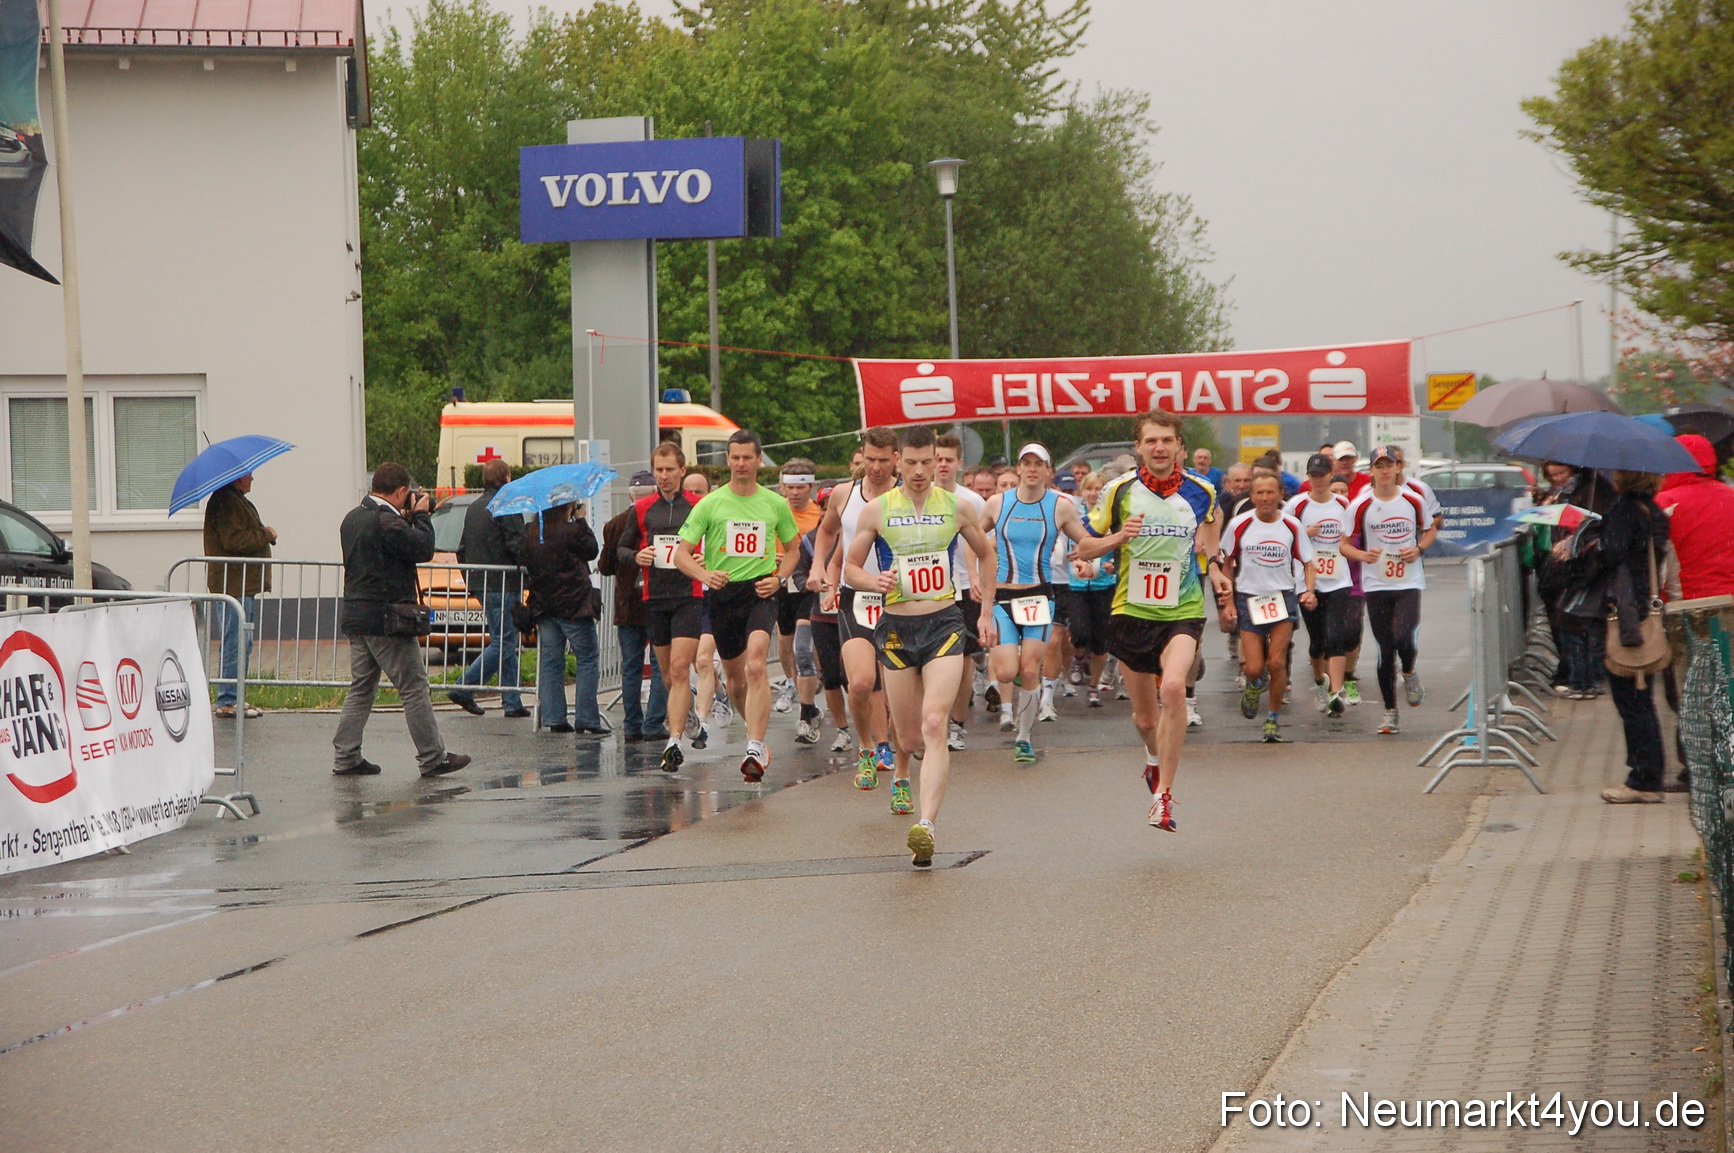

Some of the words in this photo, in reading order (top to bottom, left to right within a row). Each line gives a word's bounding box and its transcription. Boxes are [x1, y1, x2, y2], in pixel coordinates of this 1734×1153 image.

[540, 168, 712, 208] VOLVO
[1138, 525, 1189, 538] BOCK
[734, 533, 758, 553] 68
[665, 545, 674, 563] 7
[907, 555, 930, 563] MEYER
[1315, 558, 1335, 576] 39
[1385, 561, 1405, 578] 38
[908, 566, 945, 594] 100
[1144, 574, 1168, 600] 10
[866, 605, 881, 625] 11
[1023, 605, 1038, 622] 17
[1261, 602, 1279, 619] 18
[0, 673, 49, 720] HAR
[158, 687, 188, 704] NISSAN
[128, 728, 154, 749] MOTORS
[80, 739, 117, 761] SEA
[0, 832, 19, 860] rkt
